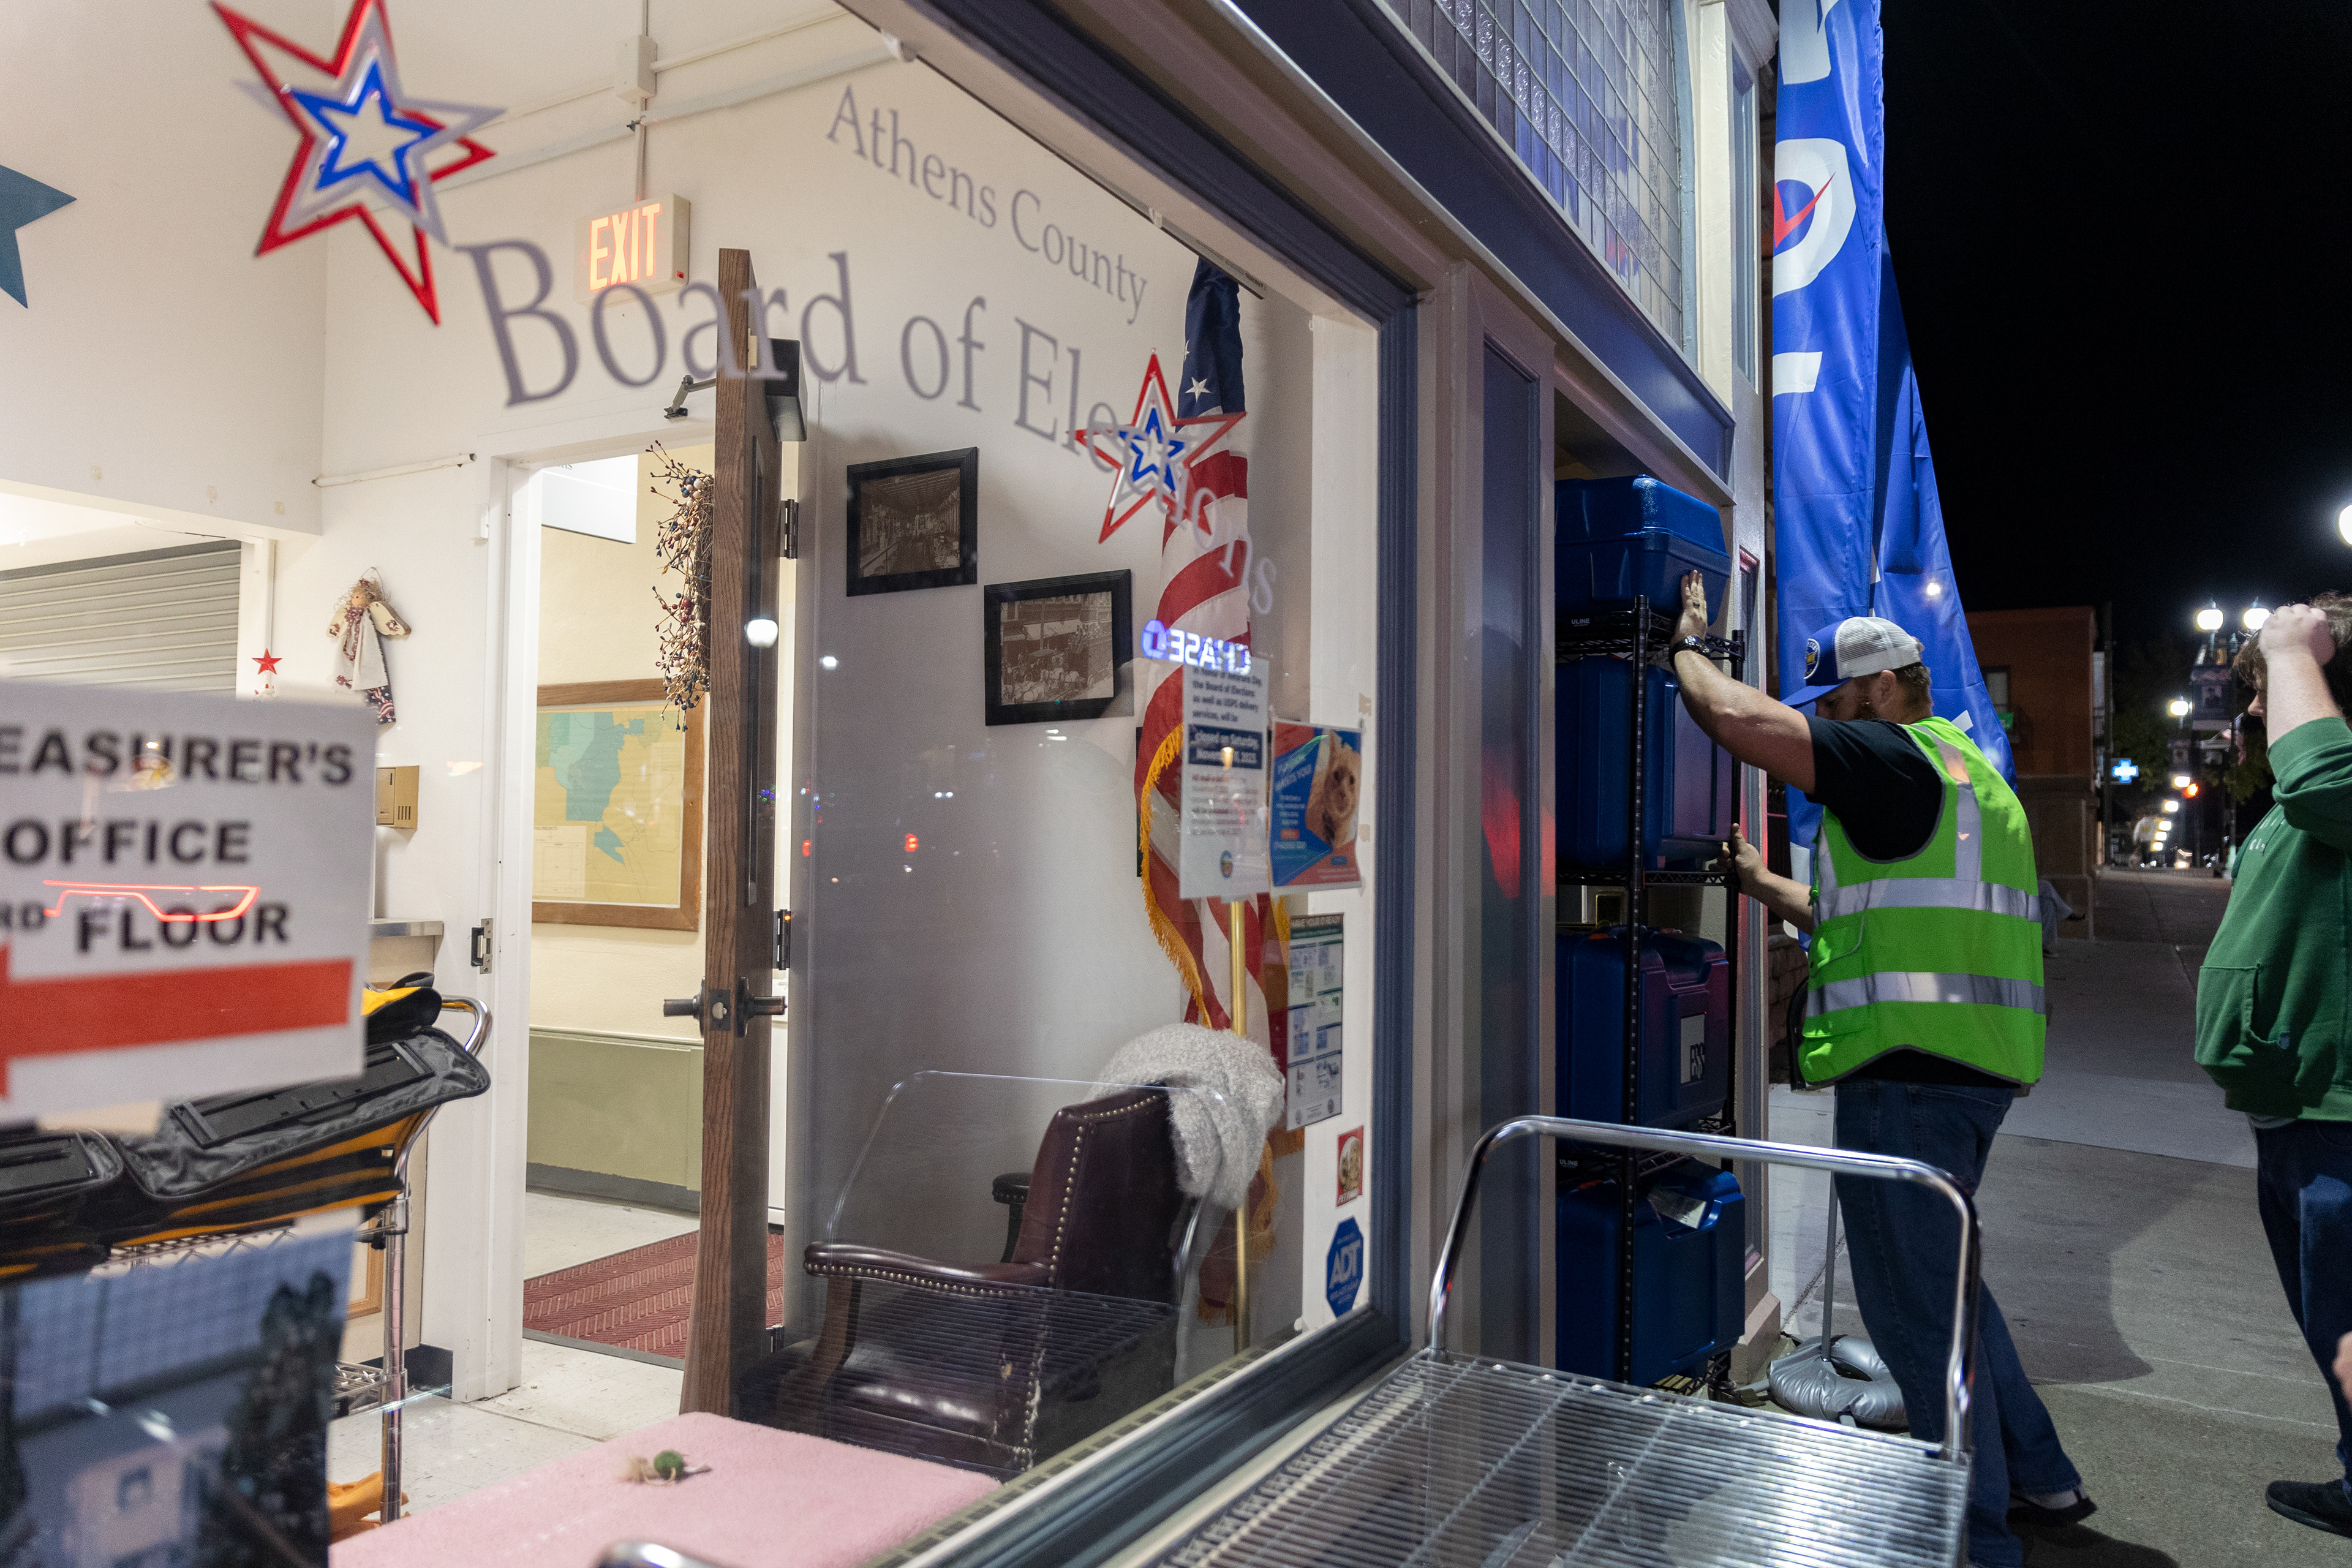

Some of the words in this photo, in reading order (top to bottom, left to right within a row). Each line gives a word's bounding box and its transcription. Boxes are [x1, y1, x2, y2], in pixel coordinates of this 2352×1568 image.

[826, 85, 998, 230] Athens
[1011, 187, 1148, 325] County
[589, 203, 662, 292] EXIT
[453, 238, 867, 408] Board
[900, 296, 987, 413] of
[1014, 317, 1277, 614] Elections
[0, 725, 355, 786] EASURER'S
[2, 816, 252, 865] OFFICE
[75, 901, 290, 954] FLOOR
[1329, 1239, 1361, 1289] ADT
